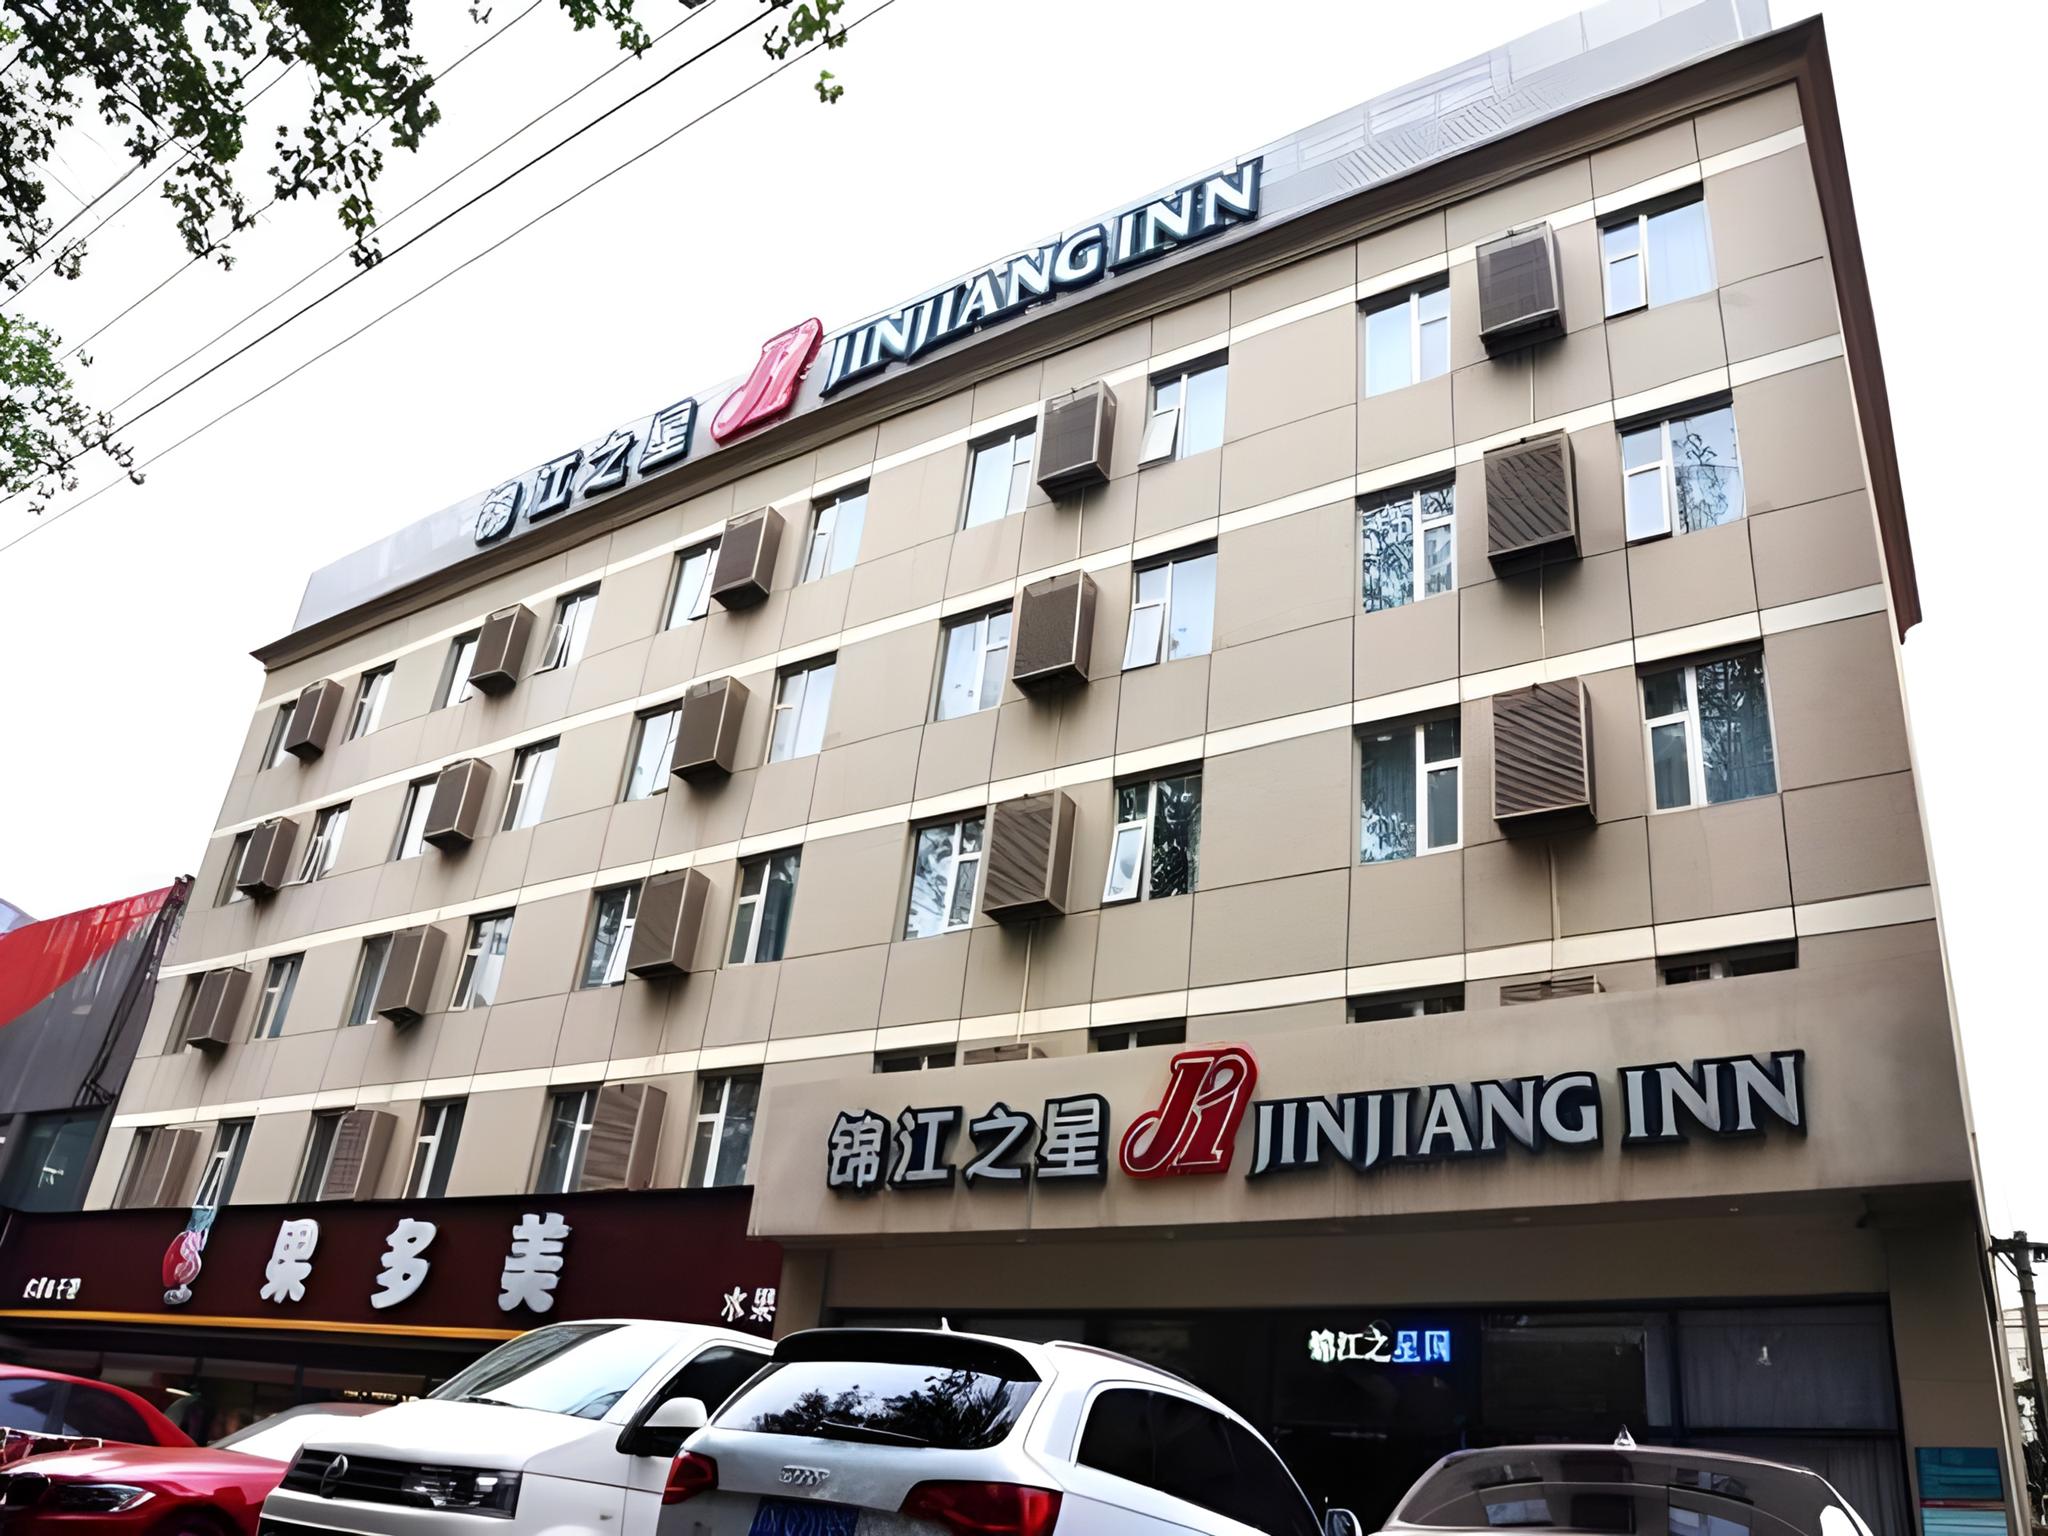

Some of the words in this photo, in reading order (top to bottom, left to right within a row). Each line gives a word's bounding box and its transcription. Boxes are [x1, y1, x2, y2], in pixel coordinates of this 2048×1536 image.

[822, 225, 1107, 397] JINJIANG
[1109, 158, 1262, 270] INN
[828, 1095, 1108, 1191] 锦江之星
[1248, 1072, 1601, 1177] JINJIANG
[1619, 1050, 1805, 1144] INN
[260, 1212, 571, 1313] 果多美
